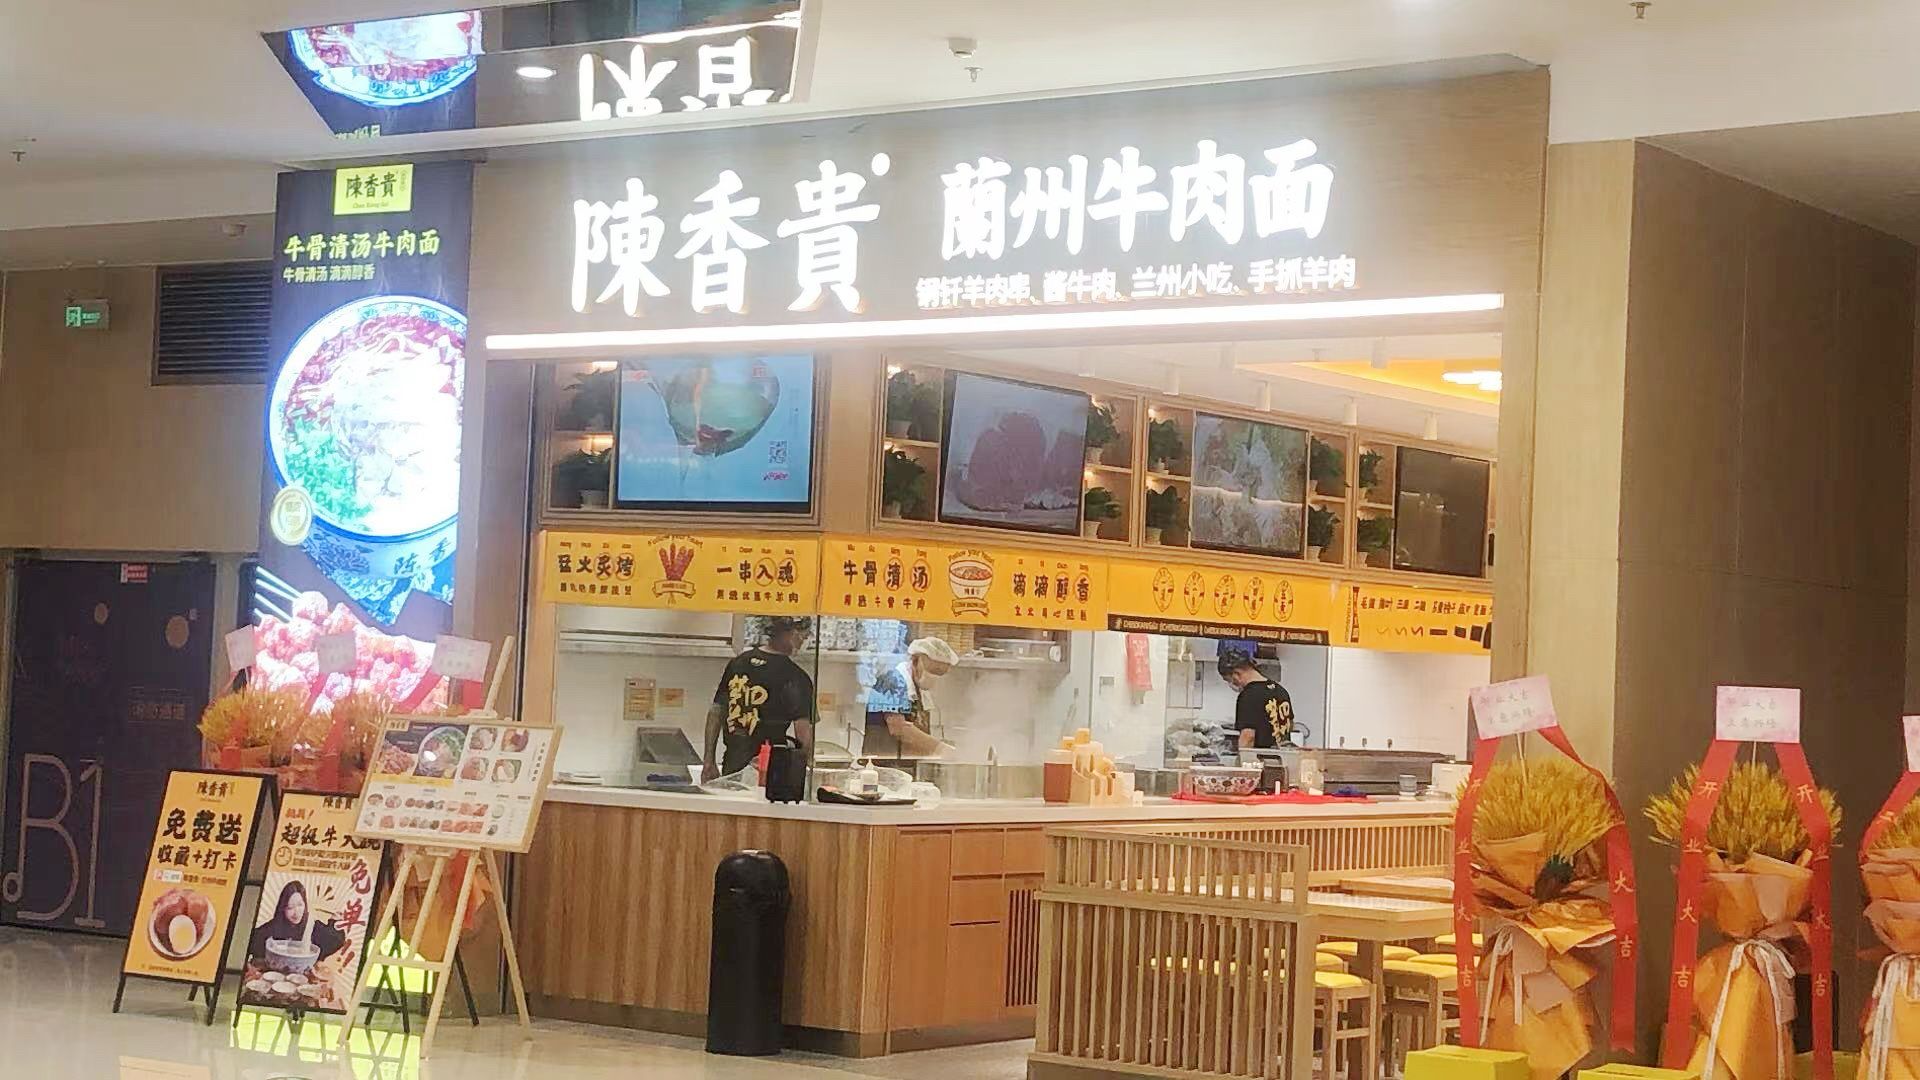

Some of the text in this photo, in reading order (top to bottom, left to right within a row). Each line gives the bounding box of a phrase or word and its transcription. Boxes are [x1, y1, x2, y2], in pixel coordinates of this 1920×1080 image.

[345, 170, 397, 199] 陳香貴
[940, 138, 1334, 262] 蘭州牛肉面
[283, 228, 440, 262] 牛骨清汤牛肉面
[571, 158, 882, 317] 陳香貴
[557, 553, 635, 578] 猛火炙烤
[716, 559, 795, 585] 一串入魂
[843, 559, 930, 591] 牛骨清汤
[1013, 571, 1090, 603] 滴滴醇香
[162, 807, 243, 845] 免费送
[157, 844, 237, 871] 收藏+打卡
[1675, 779, 1719, 988] 开业大吉
[1612, 870, 1634, 956] 大吉
